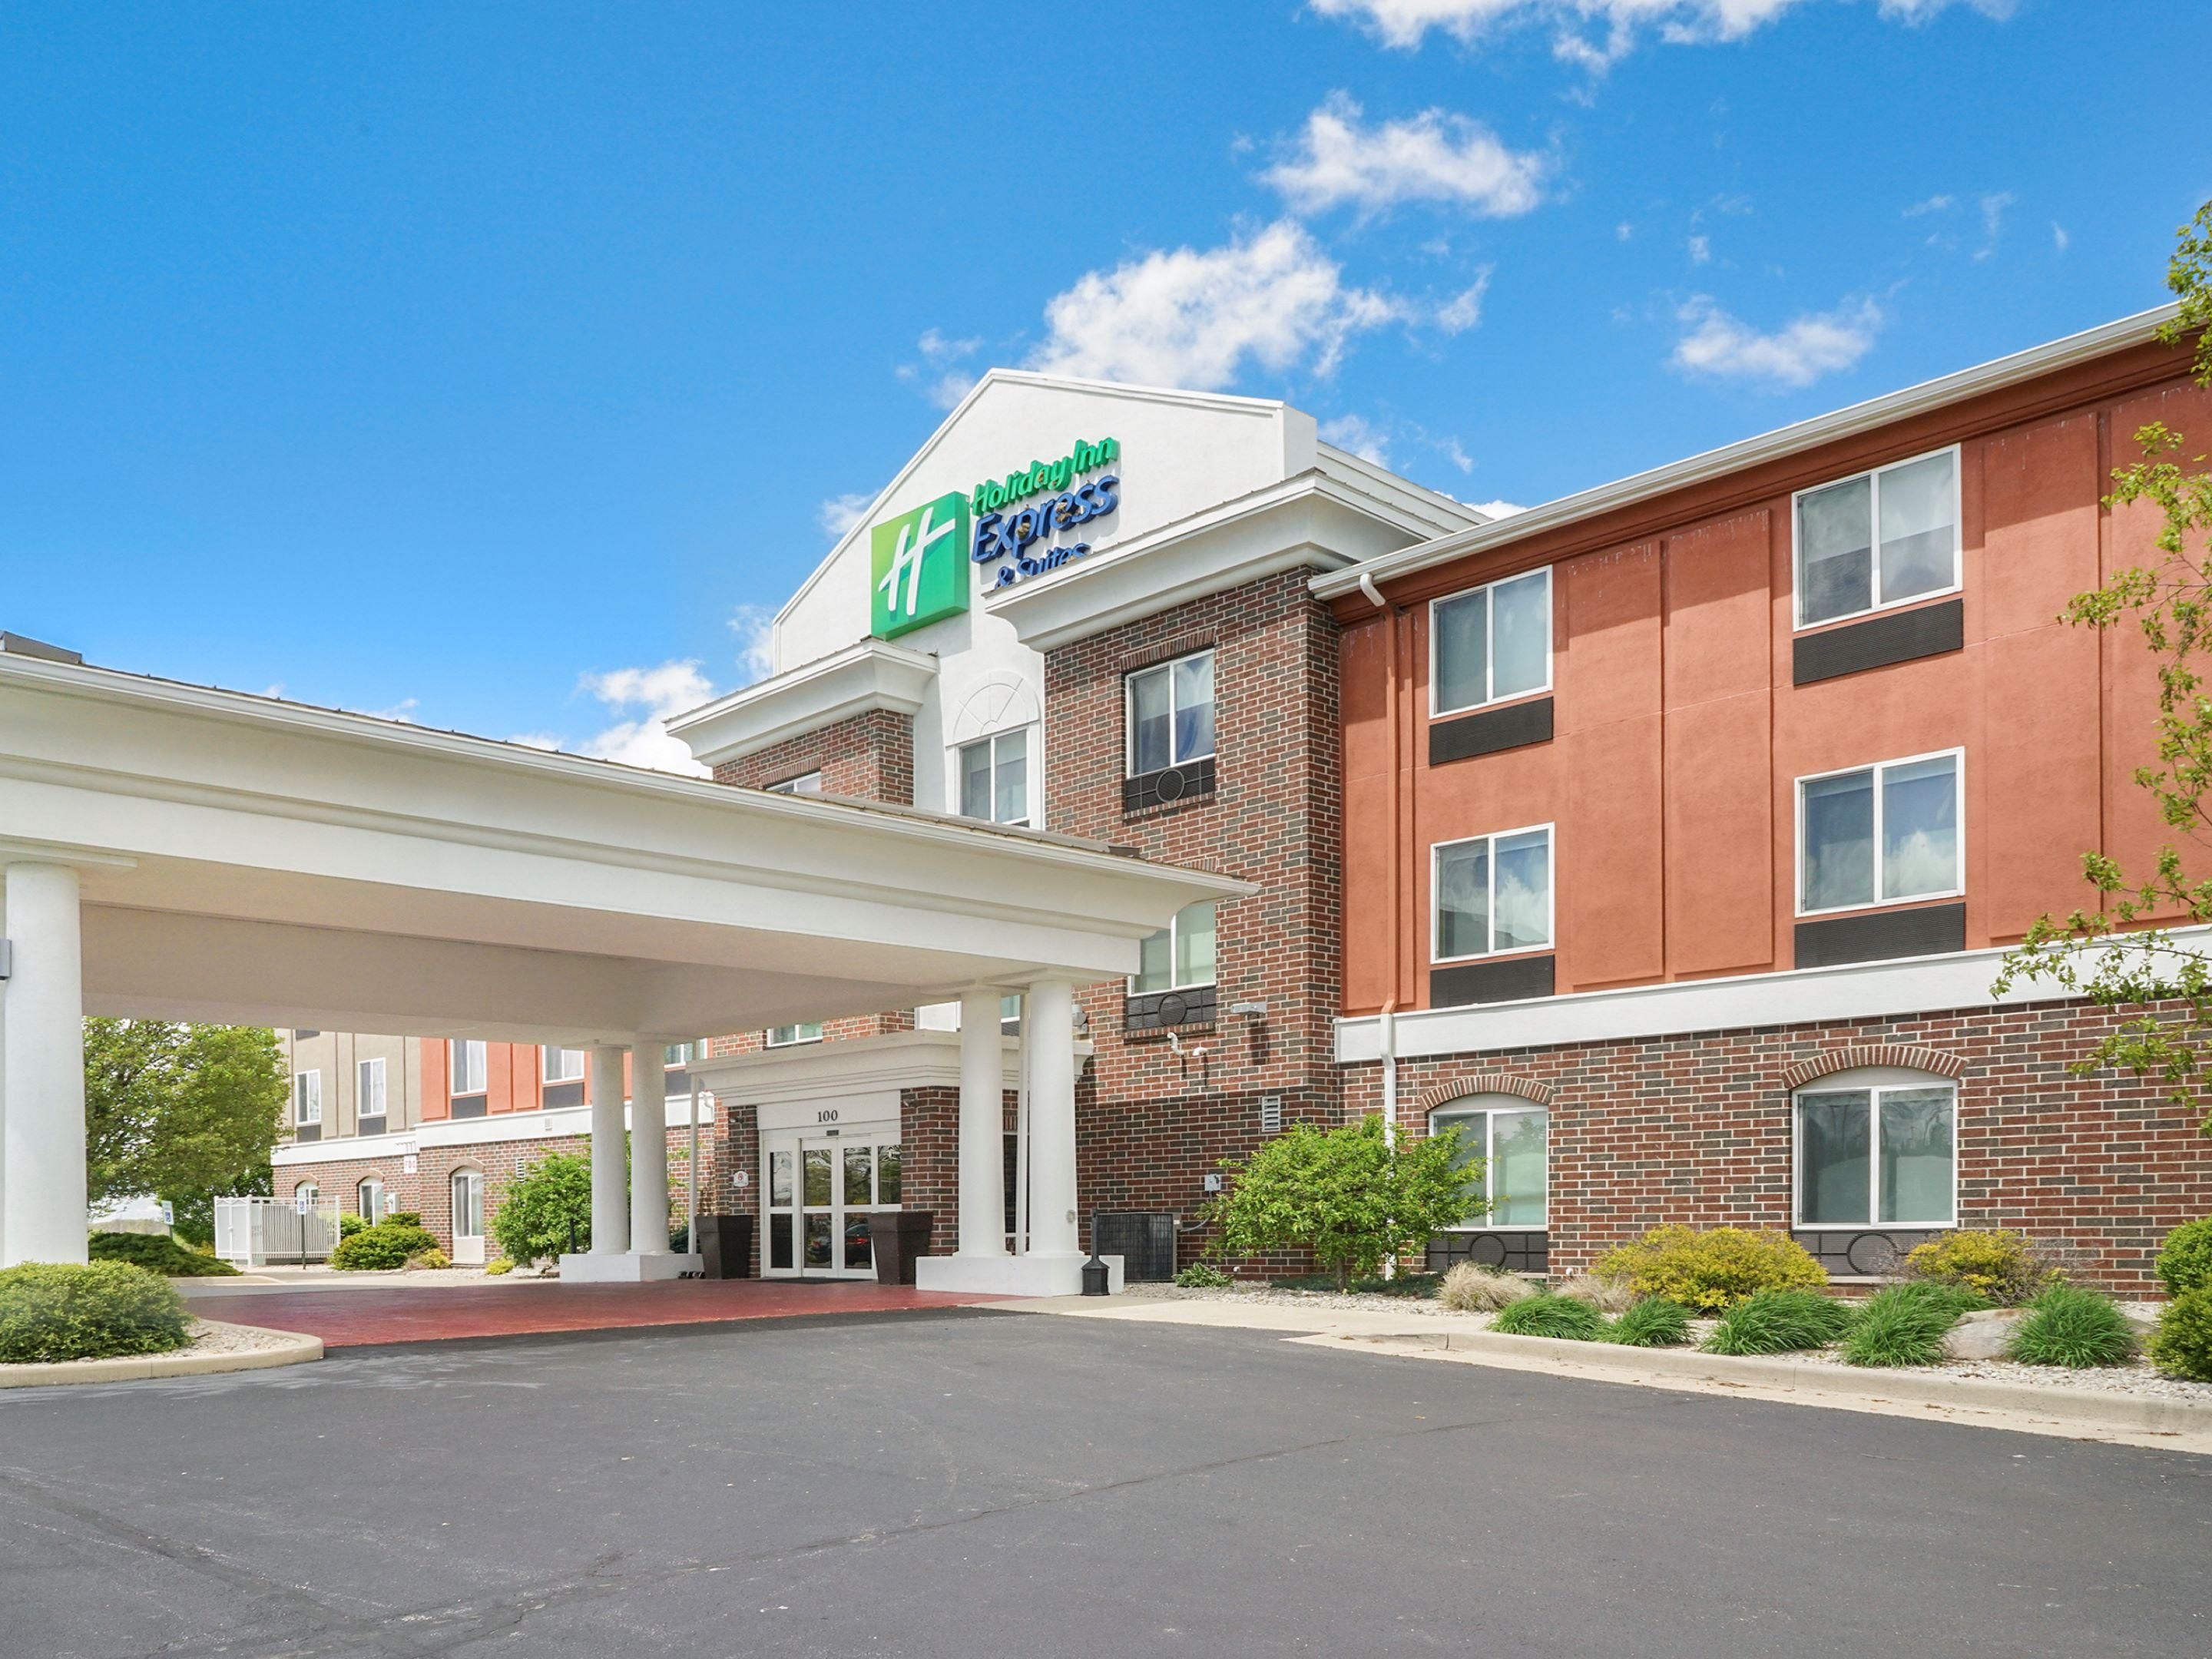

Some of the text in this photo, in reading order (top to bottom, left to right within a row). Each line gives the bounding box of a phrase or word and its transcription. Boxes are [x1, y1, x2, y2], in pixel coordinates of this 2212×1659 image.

[972, 437, 1119, 517] Holiday Inn
[972, 475, 1119, 564] Express
[995, 565, 1015, 590] &
[817, 1109, 838, 1122] 100
